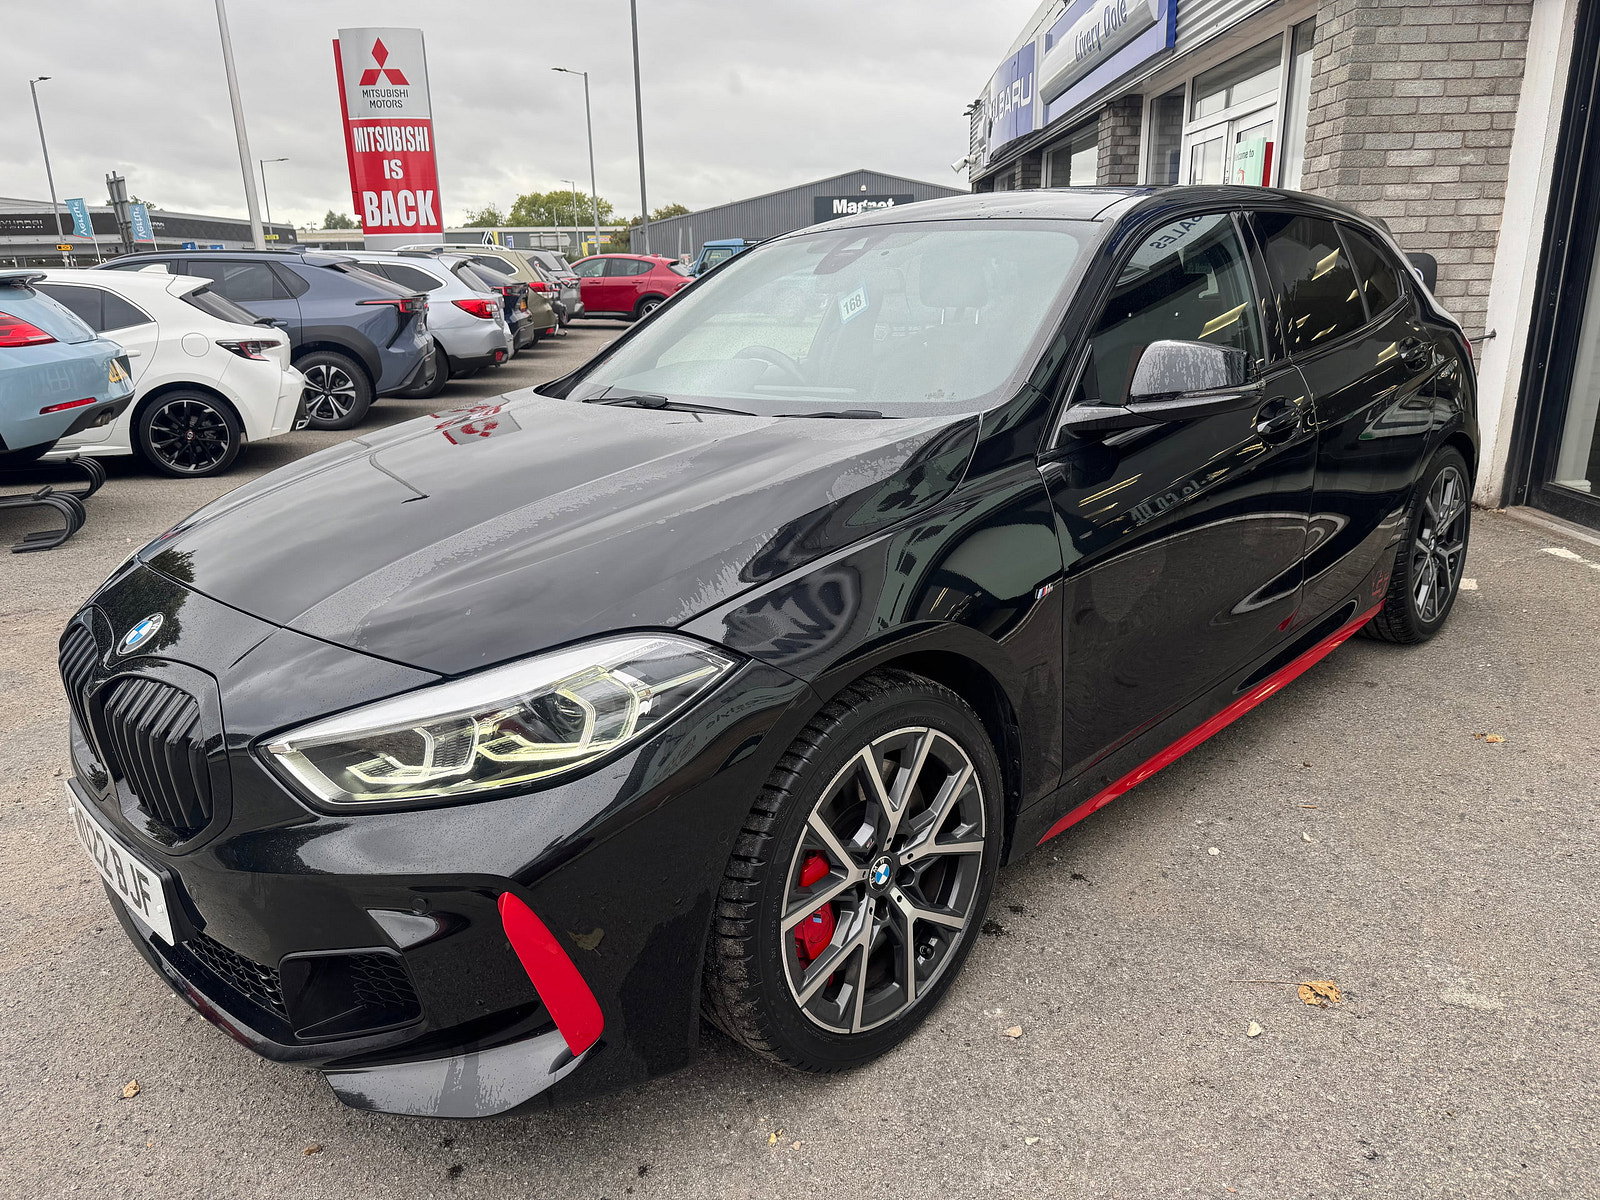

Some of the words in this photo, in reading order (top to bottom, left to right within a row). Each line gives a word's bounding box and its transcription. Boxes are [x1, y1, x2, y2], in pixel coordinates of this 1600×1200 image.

[1074, 22, 1102, 62] Livery
[1103, 0, 1128, 38] Dale
[362, 89, 409, 98] MITSUBISHI
[369, 99, 403, 108] MOTORS
[991, 72, 1033, 125] UBARU
[353, 126, 430, 152] MITSUBISHI
[383, 159, 404, 180] IS
[362, 189, 438, 227] BACK
[843, 294, 863, 315] 168
[109, 843, 152, 917] BJF
